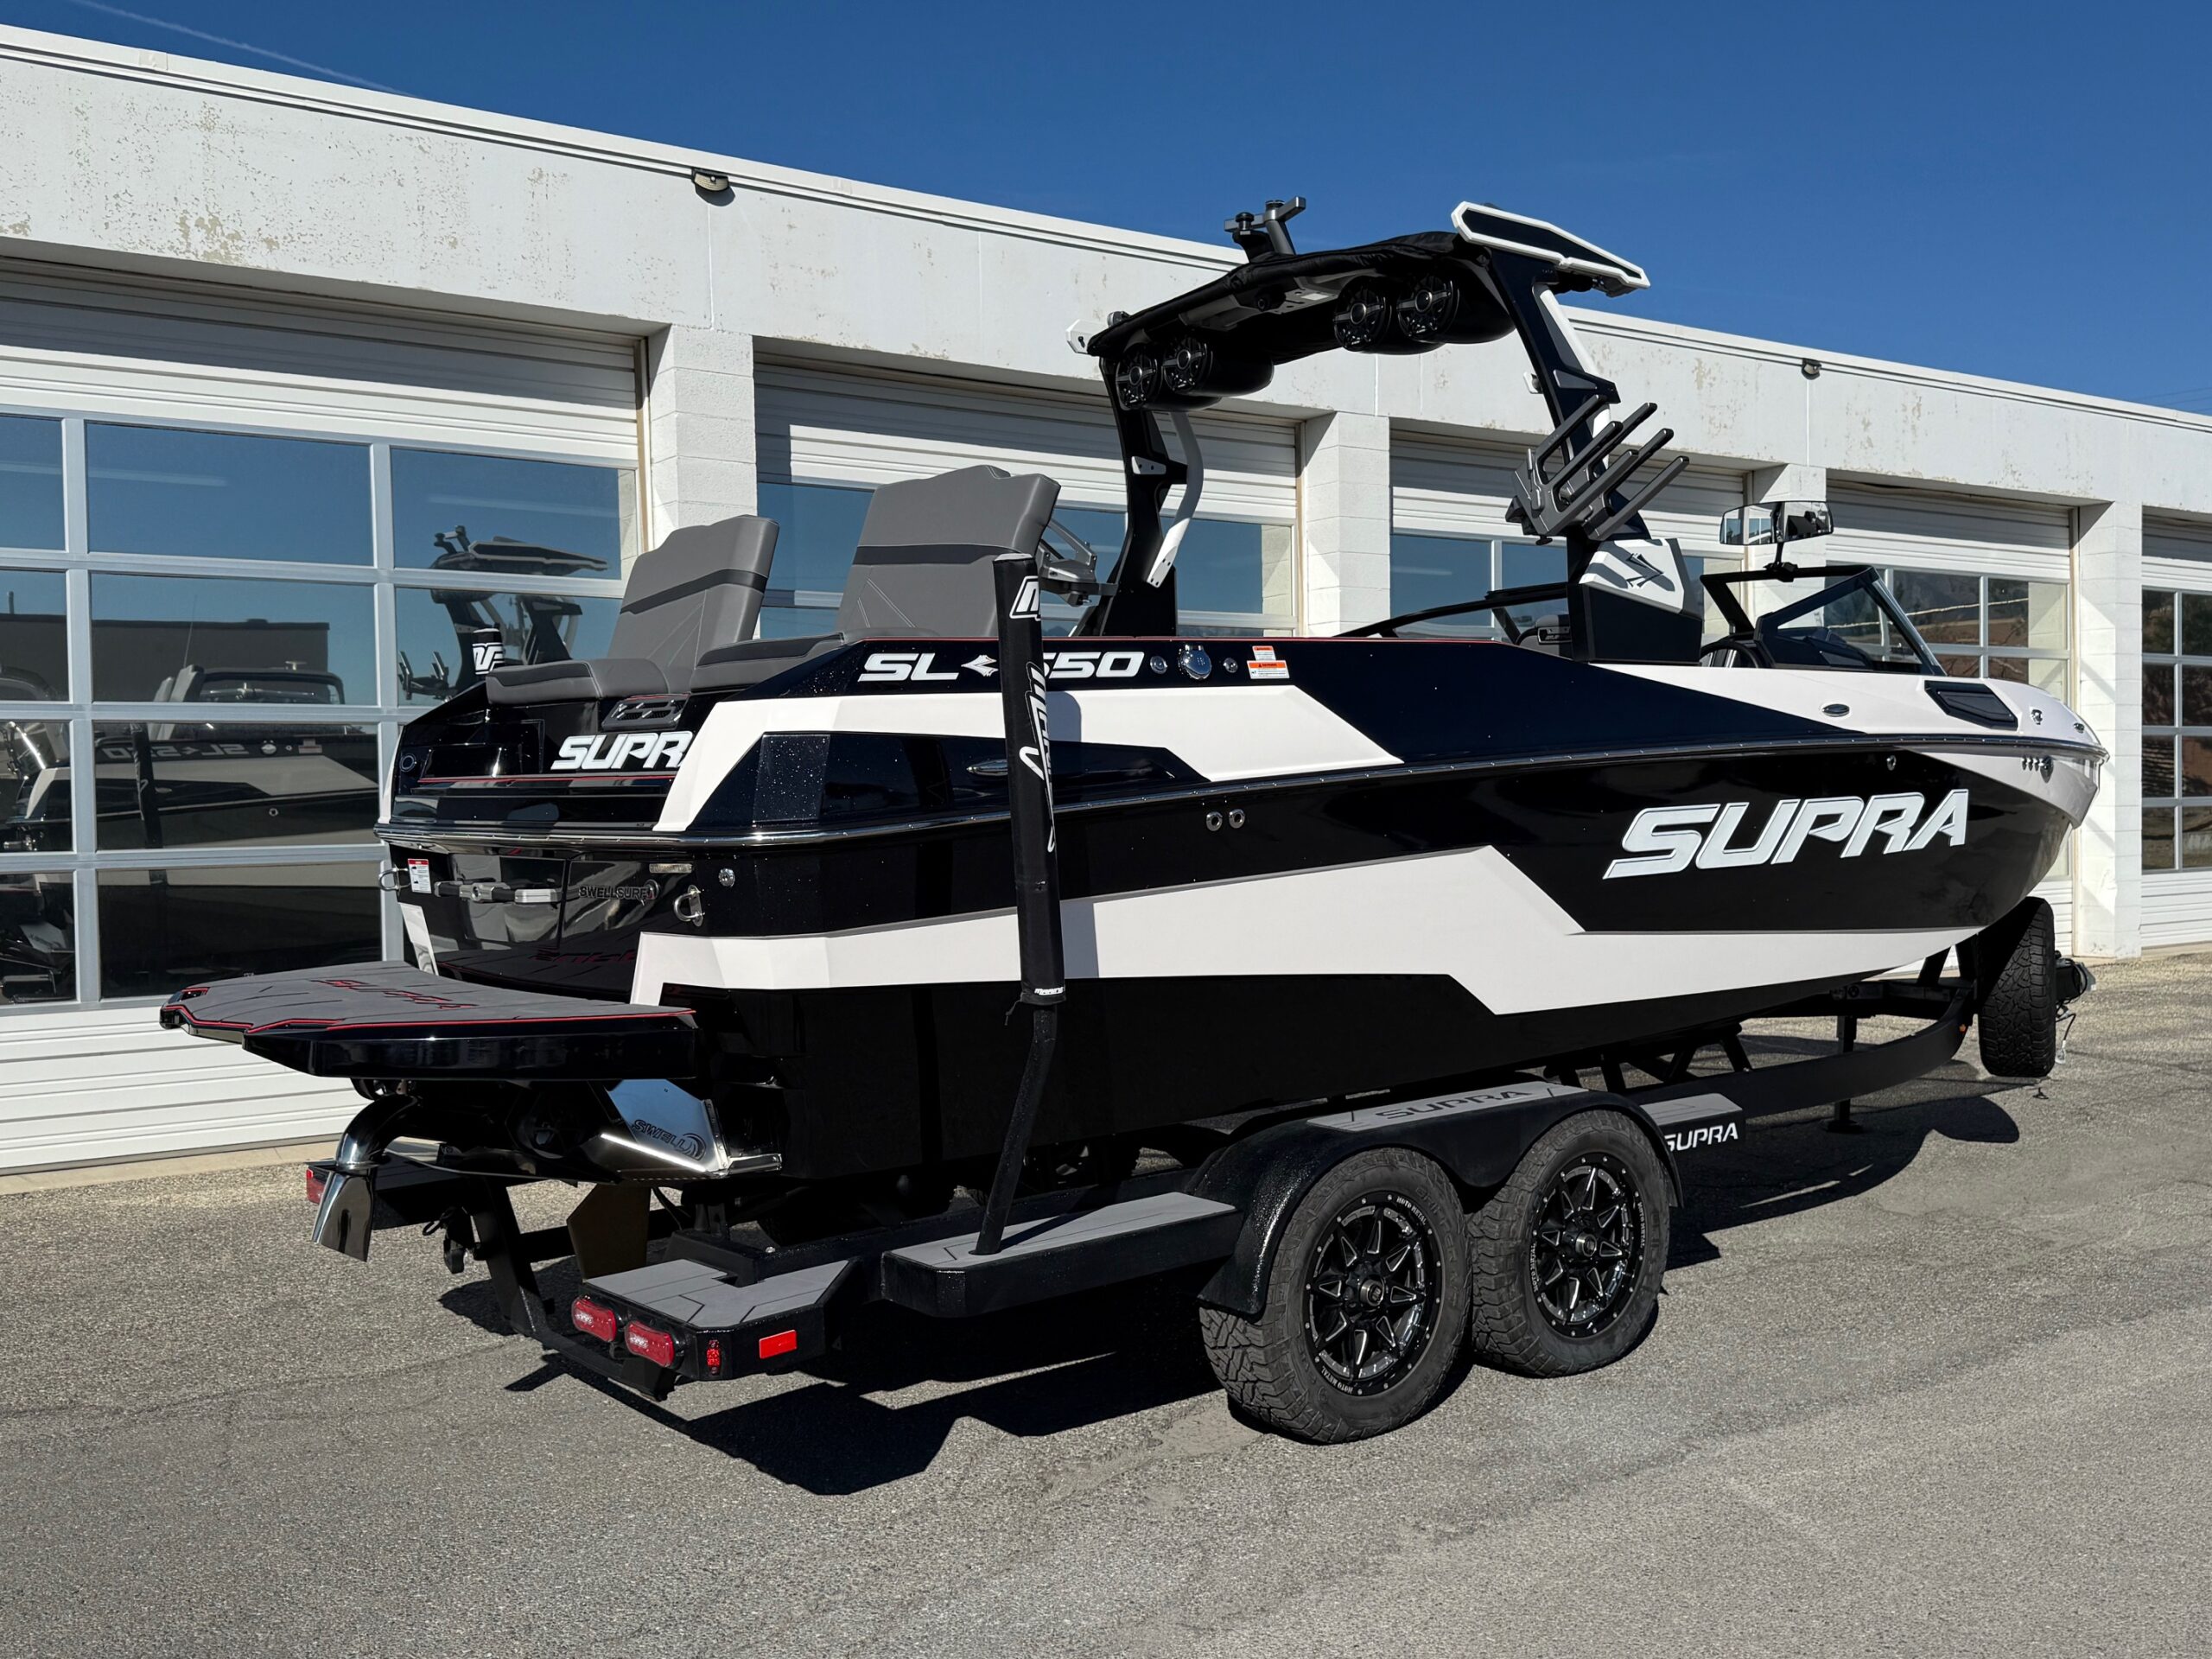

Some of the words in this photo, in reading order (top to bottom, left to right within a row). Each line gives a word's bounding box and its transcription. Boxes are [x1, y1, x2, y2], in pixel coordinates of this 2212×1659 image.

[858, 652, 960, 683] SL
[550, 730, 694, 772] SUPR
[1602, 788, 1969, 880] SUPRA
[578, 885, 647, 900] SWELLSURF
[1376, 1090, 1524, 1121] SUPRA
[632, 1118, 690, 1152] SWELL
[1396, 1196, 1412, 1209] MOTO
[1410, 1205, 1428, 1226] METAL
[1320, 1365, 1339, 1387] METAL
[1336, 1381, 1354, 1395] MOTO
